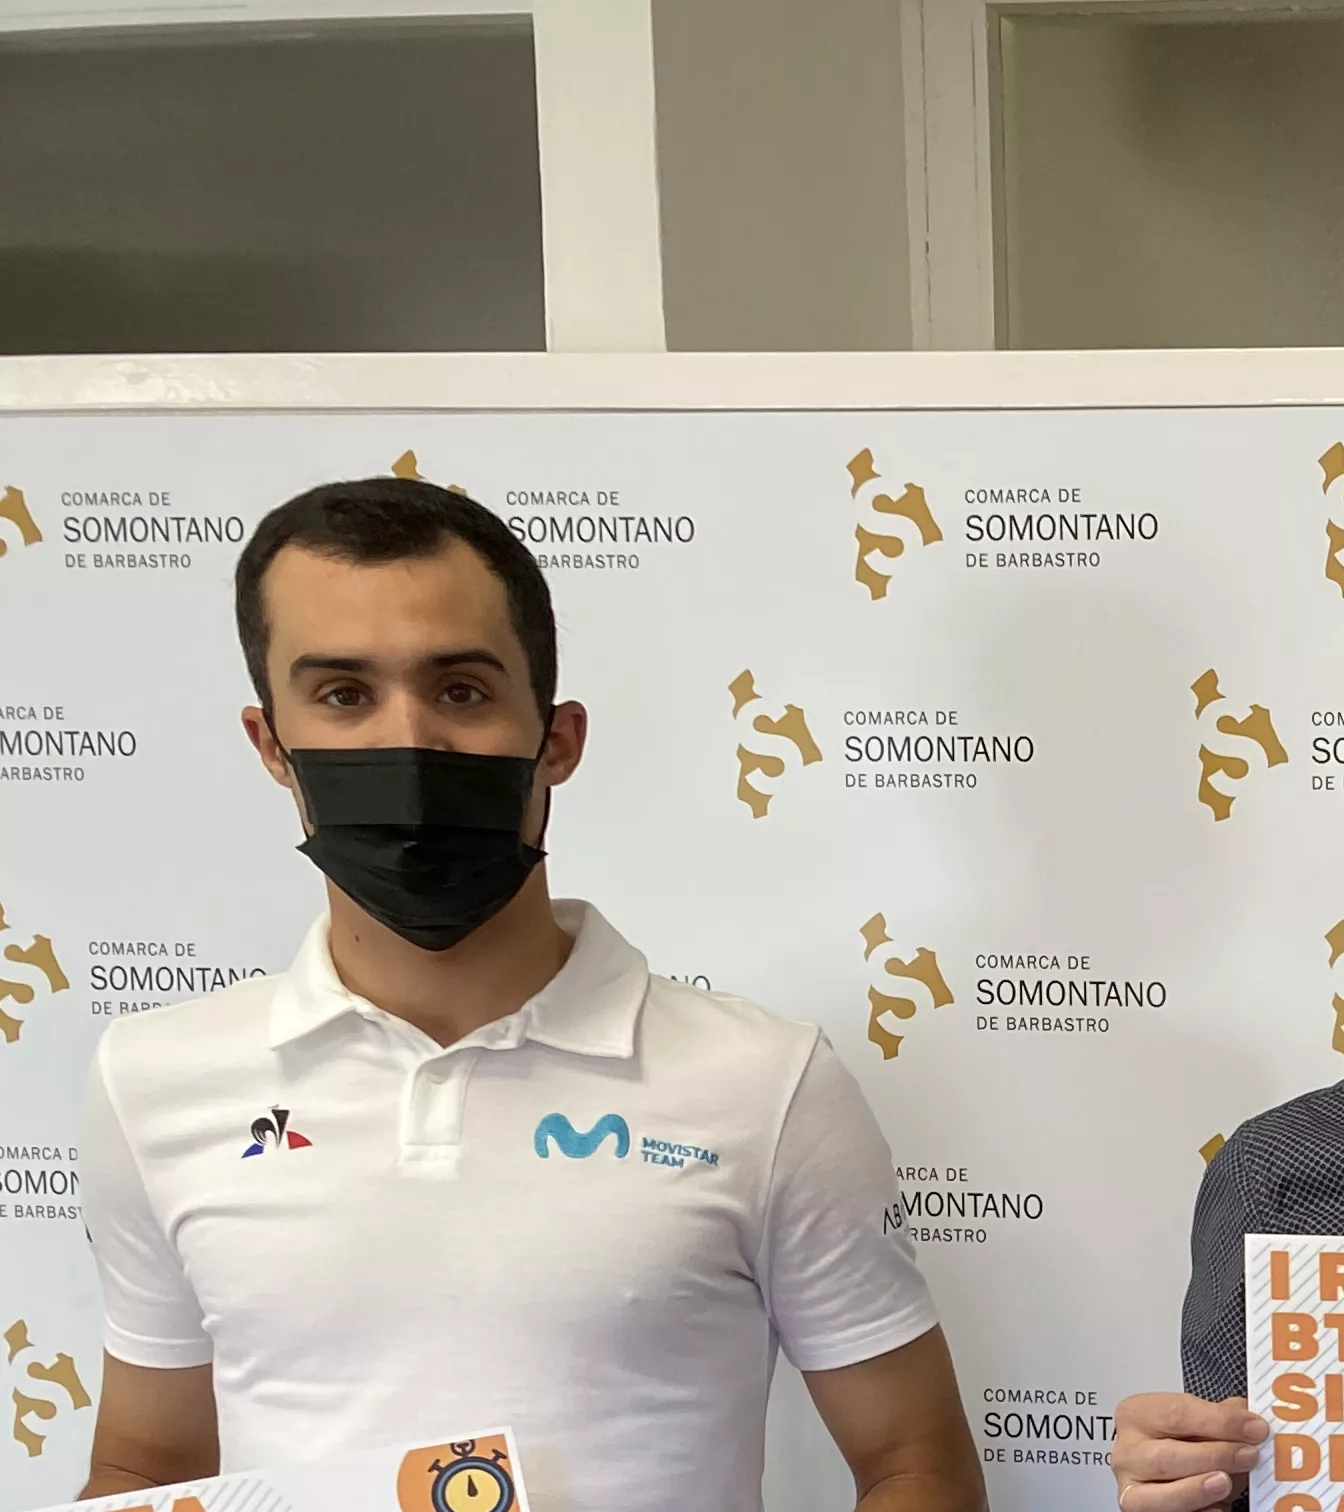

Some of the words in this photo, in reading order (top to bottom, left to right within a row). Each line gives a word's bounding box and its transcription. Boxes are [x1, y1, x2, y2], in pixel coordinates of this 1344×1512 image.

[62, 492, 142, 506] COMARCA
[149, 492, 170, 506] DE
[64, 516, 244, 543] SOMONTANO
[65, 554, 86, 568] DE
[94, 554, 191, 568] BARBASTRO
[844, 711, 928, 725] COMARCA
[936, 711, 958, 725] DE
[845, 736, 1034, 762] SOMONTANO
[846, 774, 867, 788] DE
[875, 774, 976, 788] BARBASTRO
[976, 955, 1060, 969] COMARCA
[1068, 956, 1090, 970] DE
[977, 979, 1166, 1008] SOMONTANO
[977, 1016, 998, 1030] DE
[1007, 1017, 1109, 1032] BARBASTRO
[642, 1137, 719, 1166] MOVISTAR
[642, 1151, 684, 1168] TEAM
[1271, 1251, 1289, 1300] I
